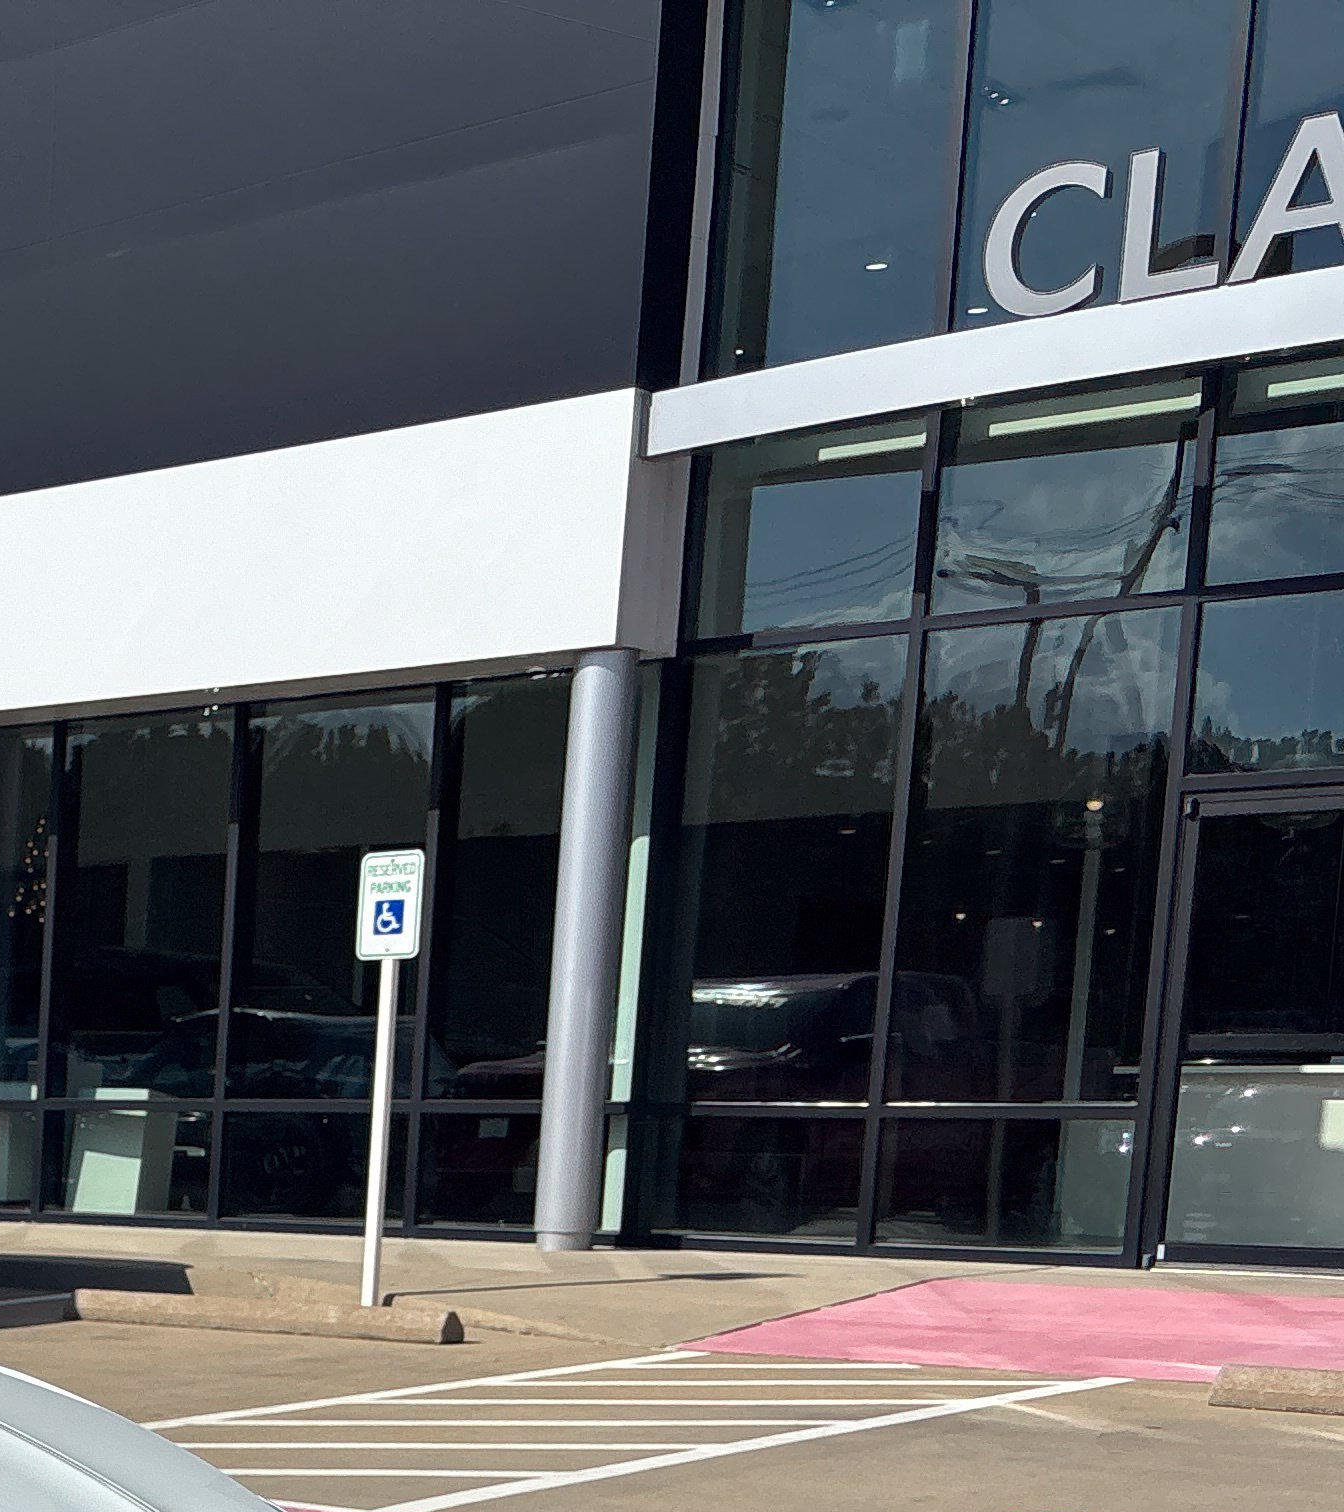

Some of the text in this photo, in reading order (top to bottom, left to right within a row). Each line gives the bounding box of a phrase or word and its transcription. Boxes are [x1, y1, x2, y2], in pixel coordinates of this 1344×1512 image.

[983, 111, 1344, 317] CLA
[367, 861, 417, 877] RESERVED
[369, 879, 412, 894] PARKING
